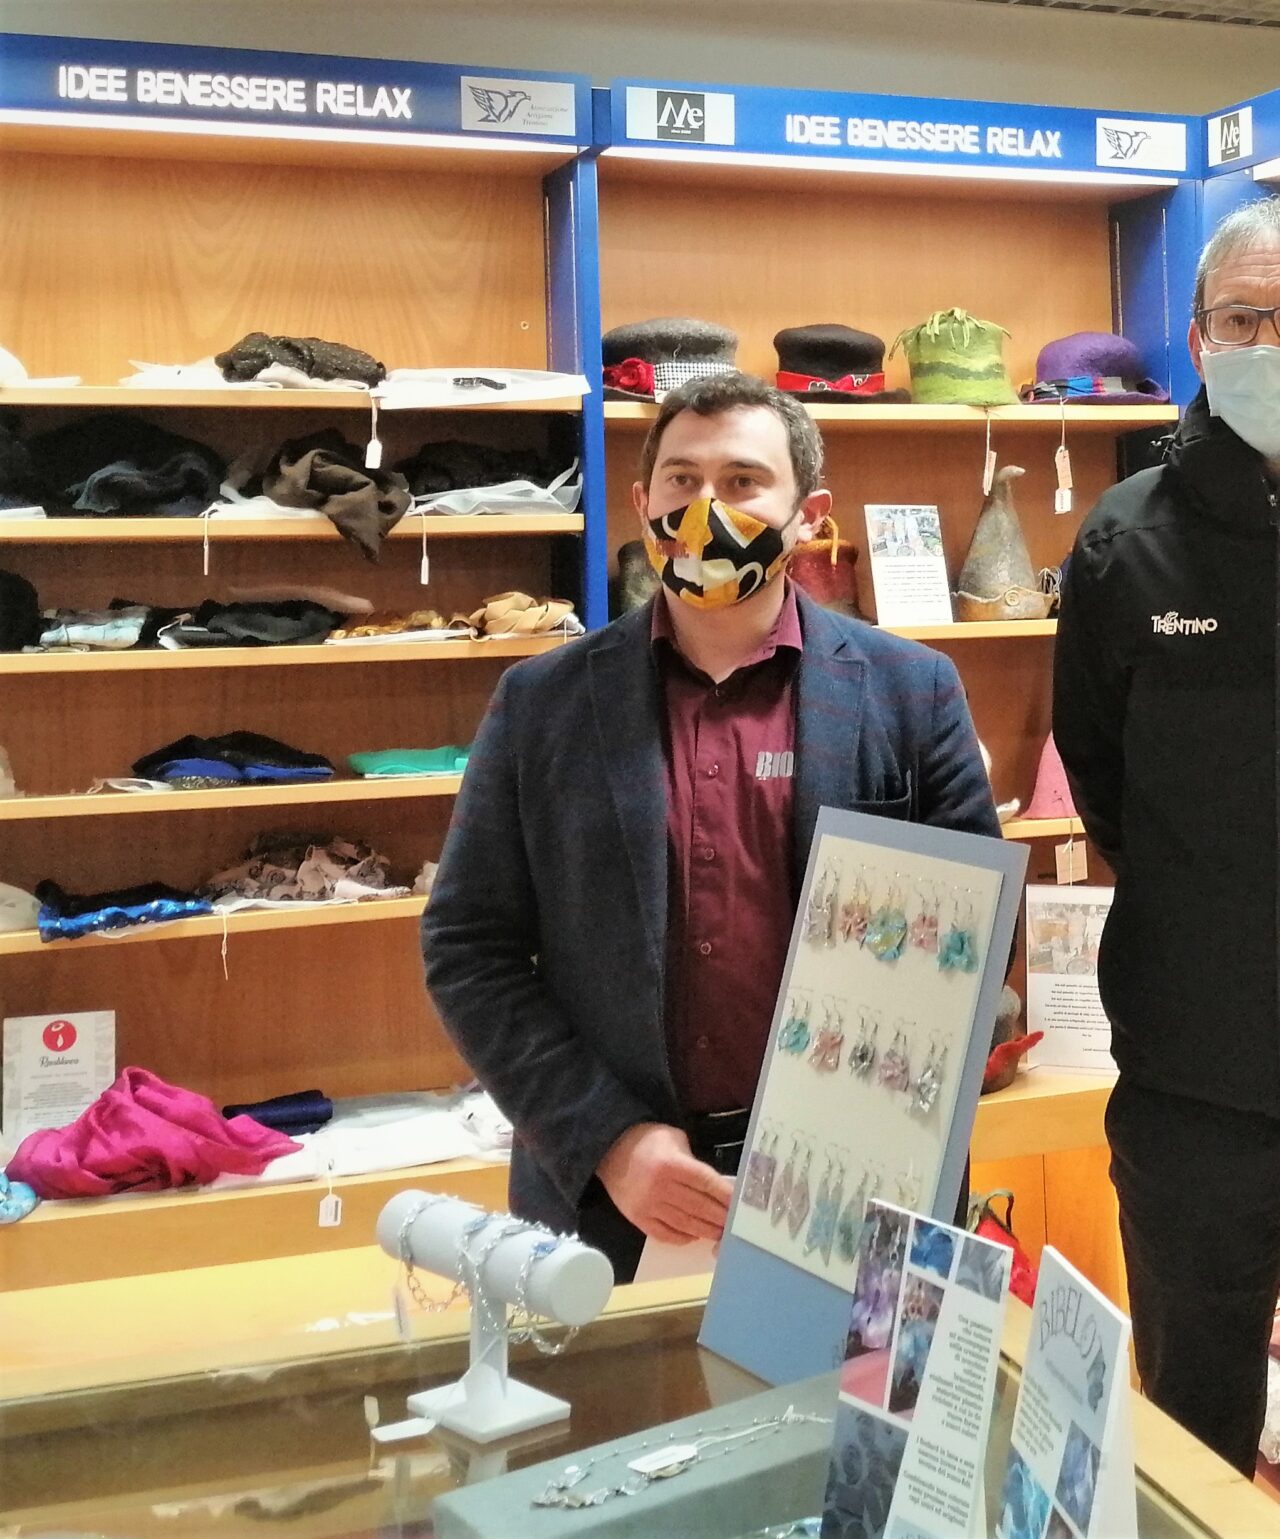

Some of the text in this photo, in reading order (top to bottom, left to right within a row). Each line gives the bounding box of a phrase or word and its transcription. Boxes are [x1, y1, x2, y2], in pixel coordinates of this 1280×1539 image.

[59, 65, 412, 119] IDEE BENESSERE RELAX
[657, 96, 704, 129] Me
[785, 114, 1062, 158] IDEE BENESSERE RELAX
[1221, 118, 1240, 150] Me
[1151, 614, 1218, 635] TRENTINO
